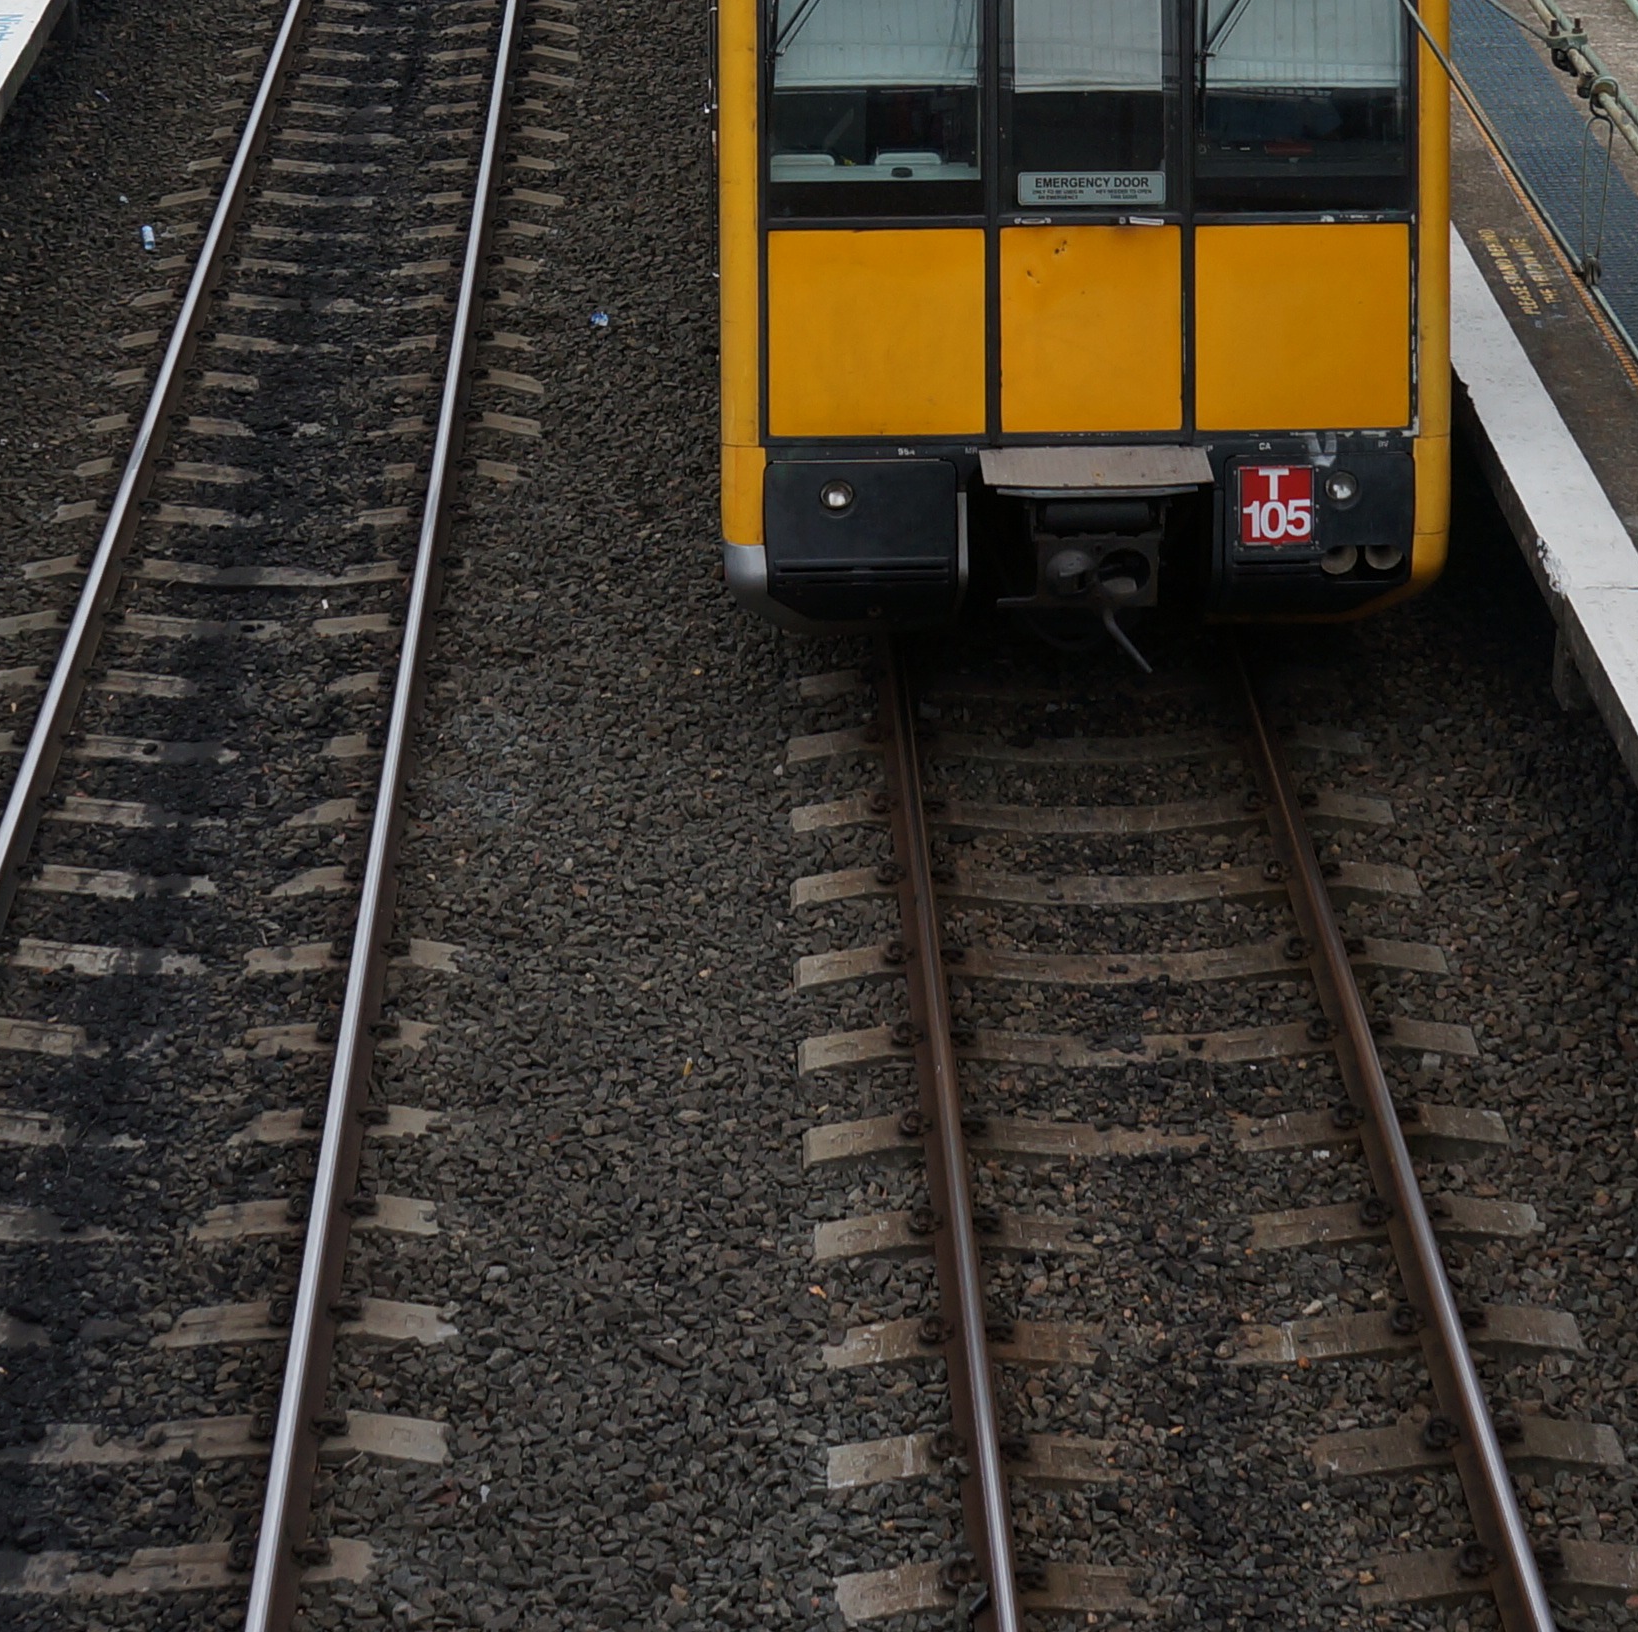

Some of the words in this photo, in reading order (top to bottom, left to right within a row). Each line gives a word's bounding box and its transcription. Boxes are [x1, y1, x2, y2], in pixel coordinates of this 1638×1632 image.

[1035, 177, 1110, 188] EMERGENCY
[1114, 177, 1149, 188] DOOR
[1477, 229, 1508, 257] BEHIND
[1494, 258, 1525, 285] STAND
[1521, 256, 1553, 287] YELLOW
[1509, 285, 1542, 315] PLEASE
[1259, 442, 1271, 451] CA
[1258, 468, 1289, 500] T
[1243, 499, 1311, 539] 105
